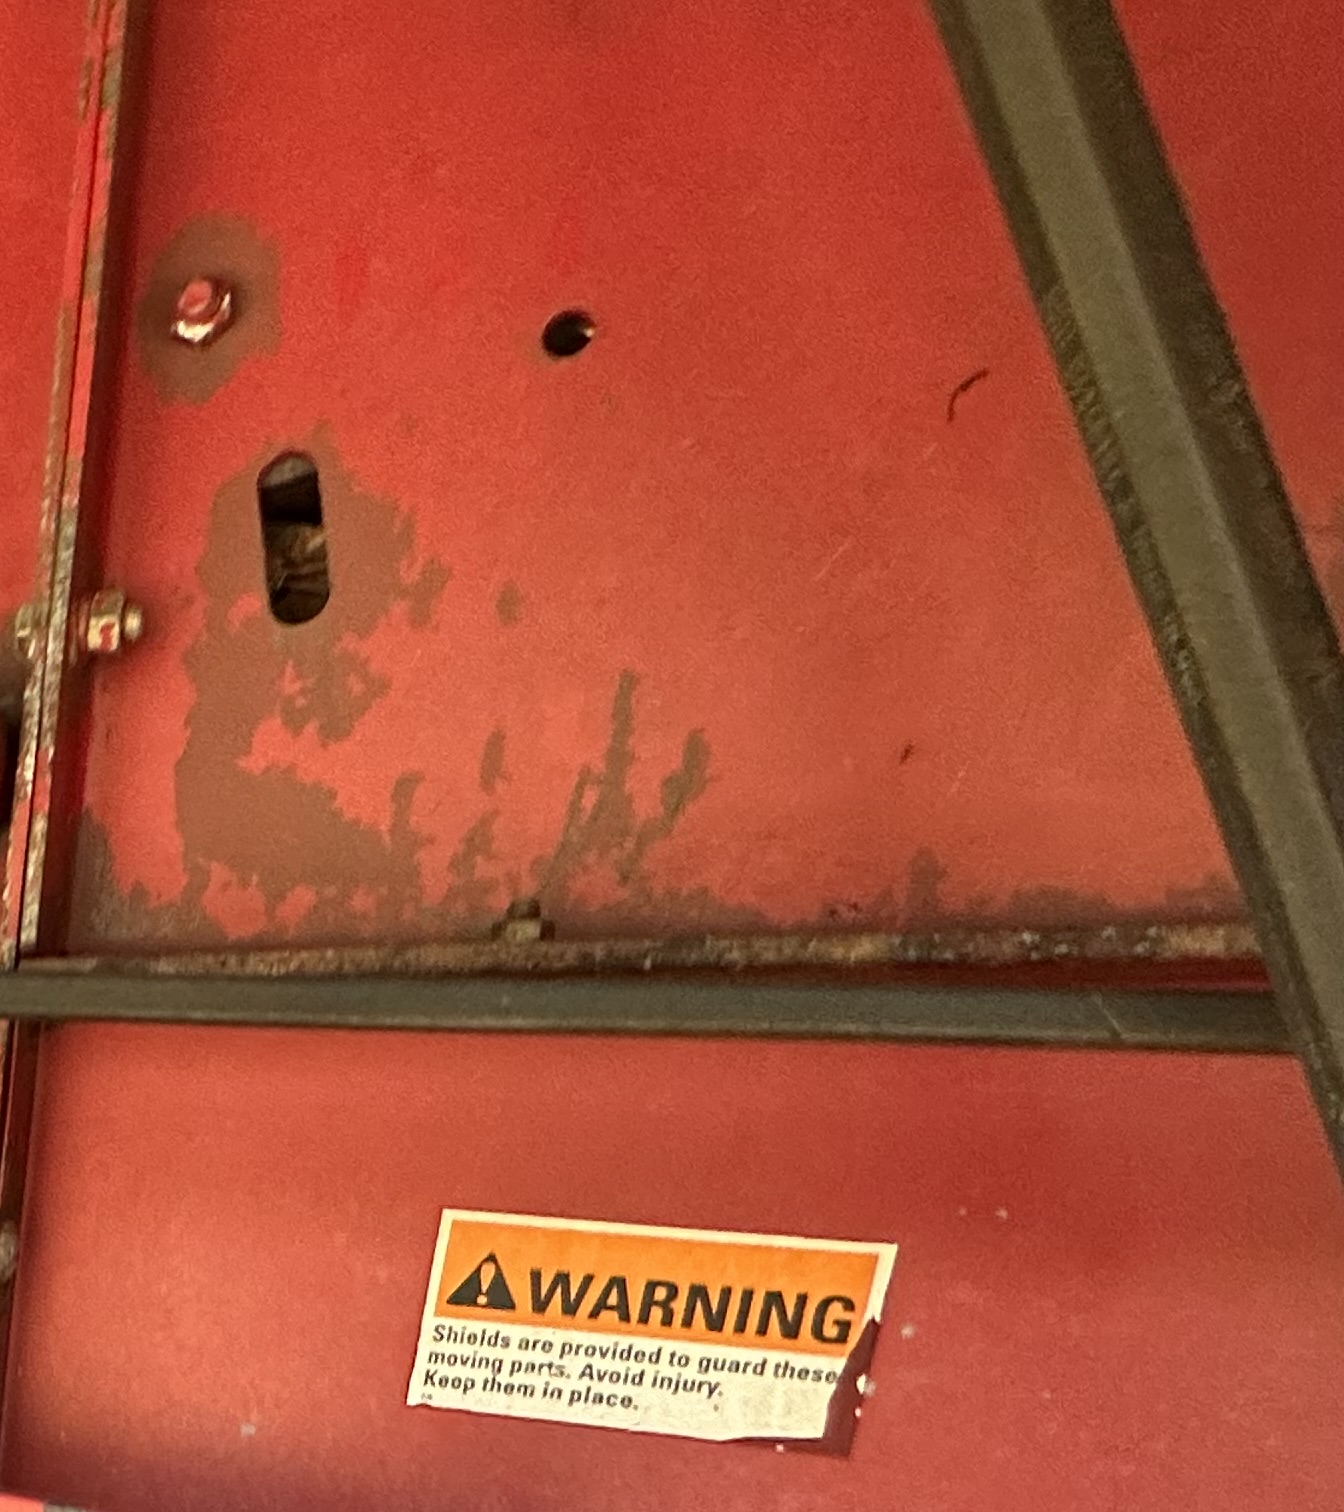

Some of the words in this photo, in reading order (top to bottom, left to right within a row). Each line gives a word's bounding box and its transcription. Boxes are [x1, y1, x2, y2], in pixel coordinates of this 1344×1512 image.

[527, 1266, 856, 1346] WARNING
[426, 1350, 504, 1376] moving
[508, 1358, 572, 1380] parts.
[577, 1363, 646, 1387] Avoid
[650, 1370, 724, 1399] injury.
[432, 1323, 512, 1349] Shields
[517, 1337, 554, 1354] are
[558, 1341, 664, 1366] provided
[668, 1350, 690, 1368] to
[696, 1357, 768, 1376] guard
[773, 1360, 839, 1384] these
[423, 1368, 476, 1395] Keep
[481, 1374, 536, 1398] them
[540, 1381, 563, 1401] in
[567, 1386, 640, 1411] place.
